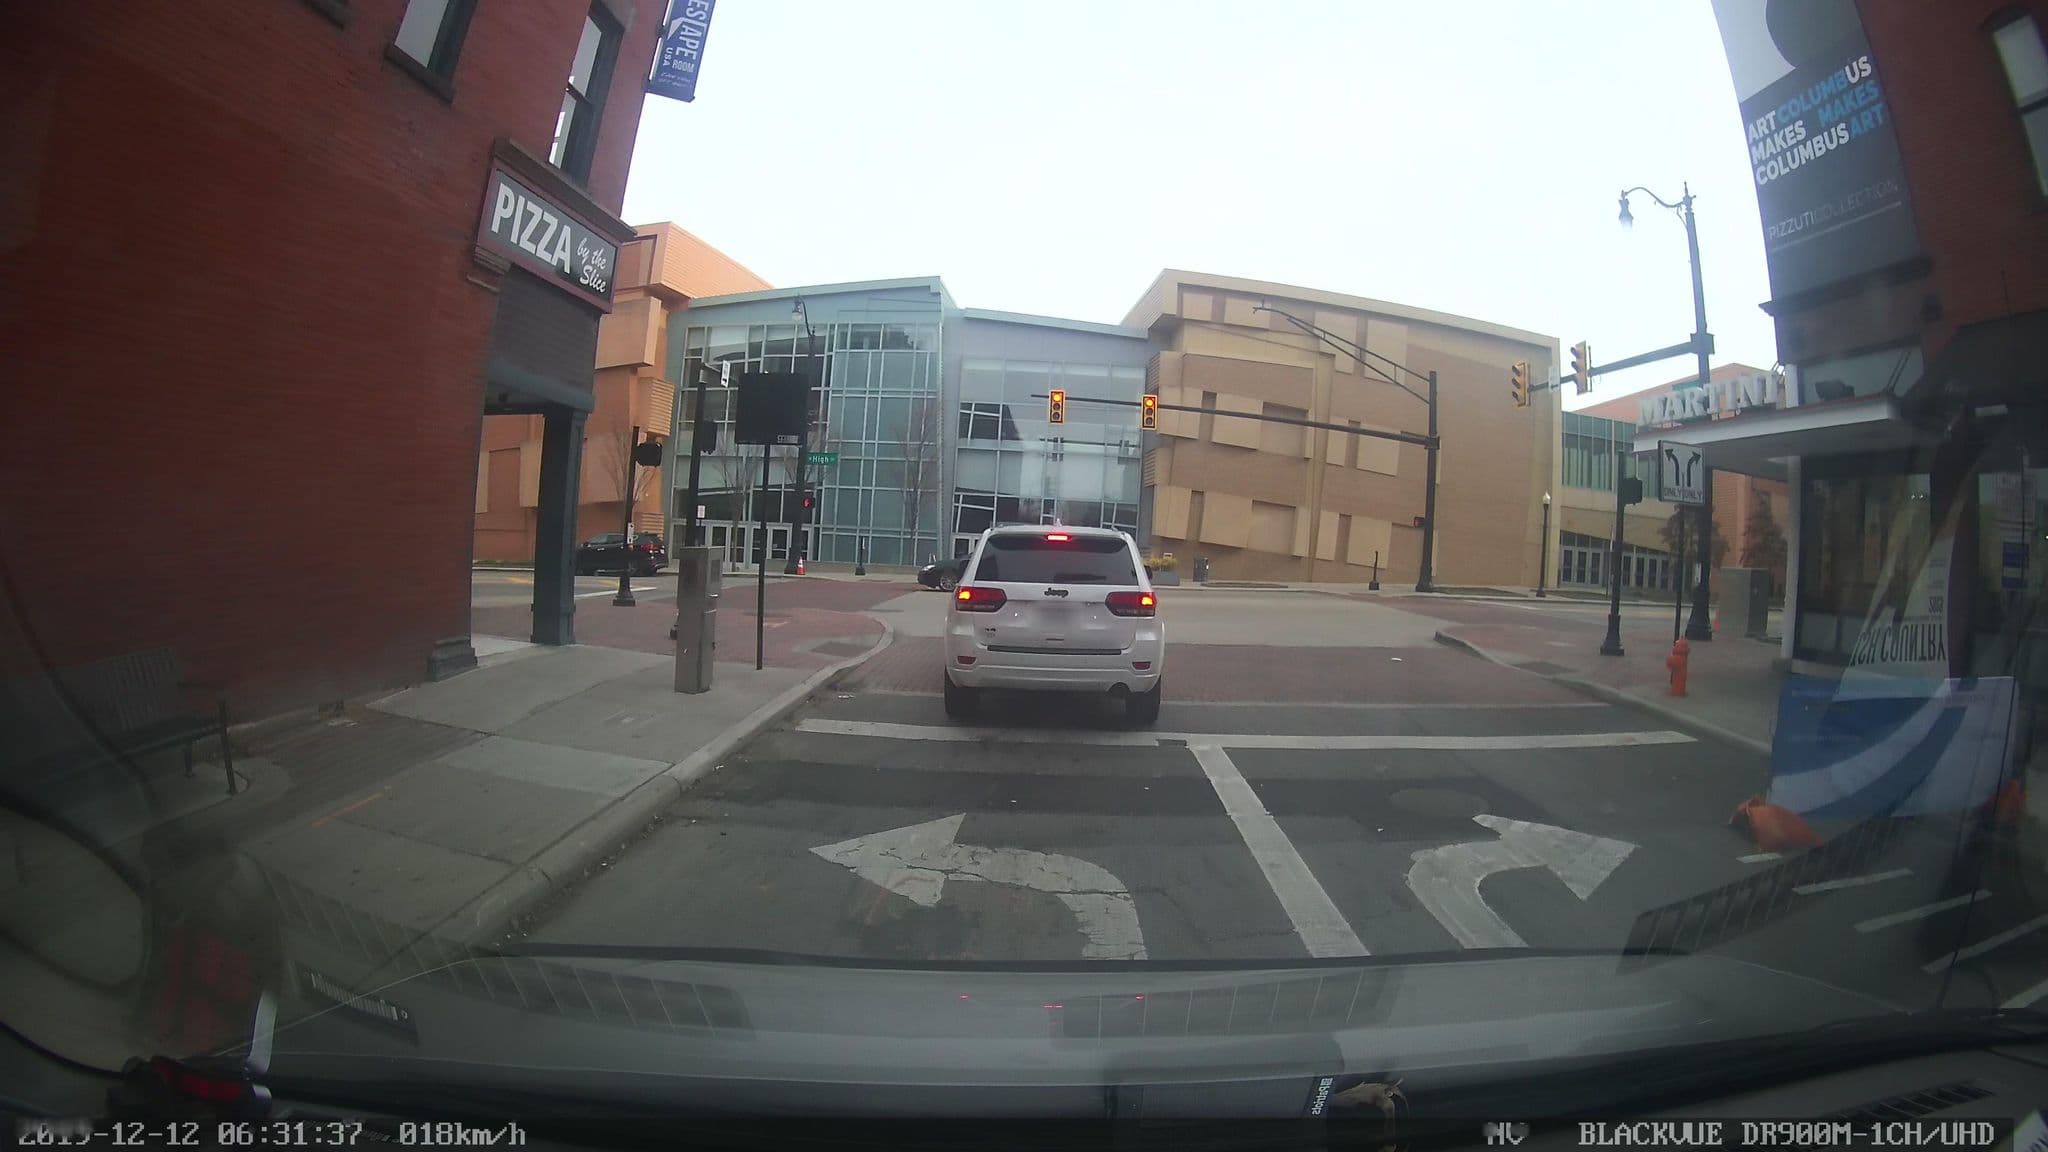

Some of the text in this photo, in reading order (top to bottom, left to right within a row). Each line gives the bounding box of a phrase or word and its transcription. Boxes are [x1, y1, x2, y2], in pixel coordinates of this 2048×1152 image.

[663, 47, 673, 66] USA
[1748, 56, 1872, 141] ART COLUMBUS
[1751, 79, 1880, 164] MAKES MAKES
[1756, 103, 1886, 185] COLUMBUS ART
[491, 182, 571, 274] PIZZA
[577, 237, 606, 269] by the
[580, 264, 606, 292] Slice
[812, 455, 829, 464] High
[1664, 487, 1703, 500] ONLY ONLY
[1044, 587, 1069, 598] Jeep
